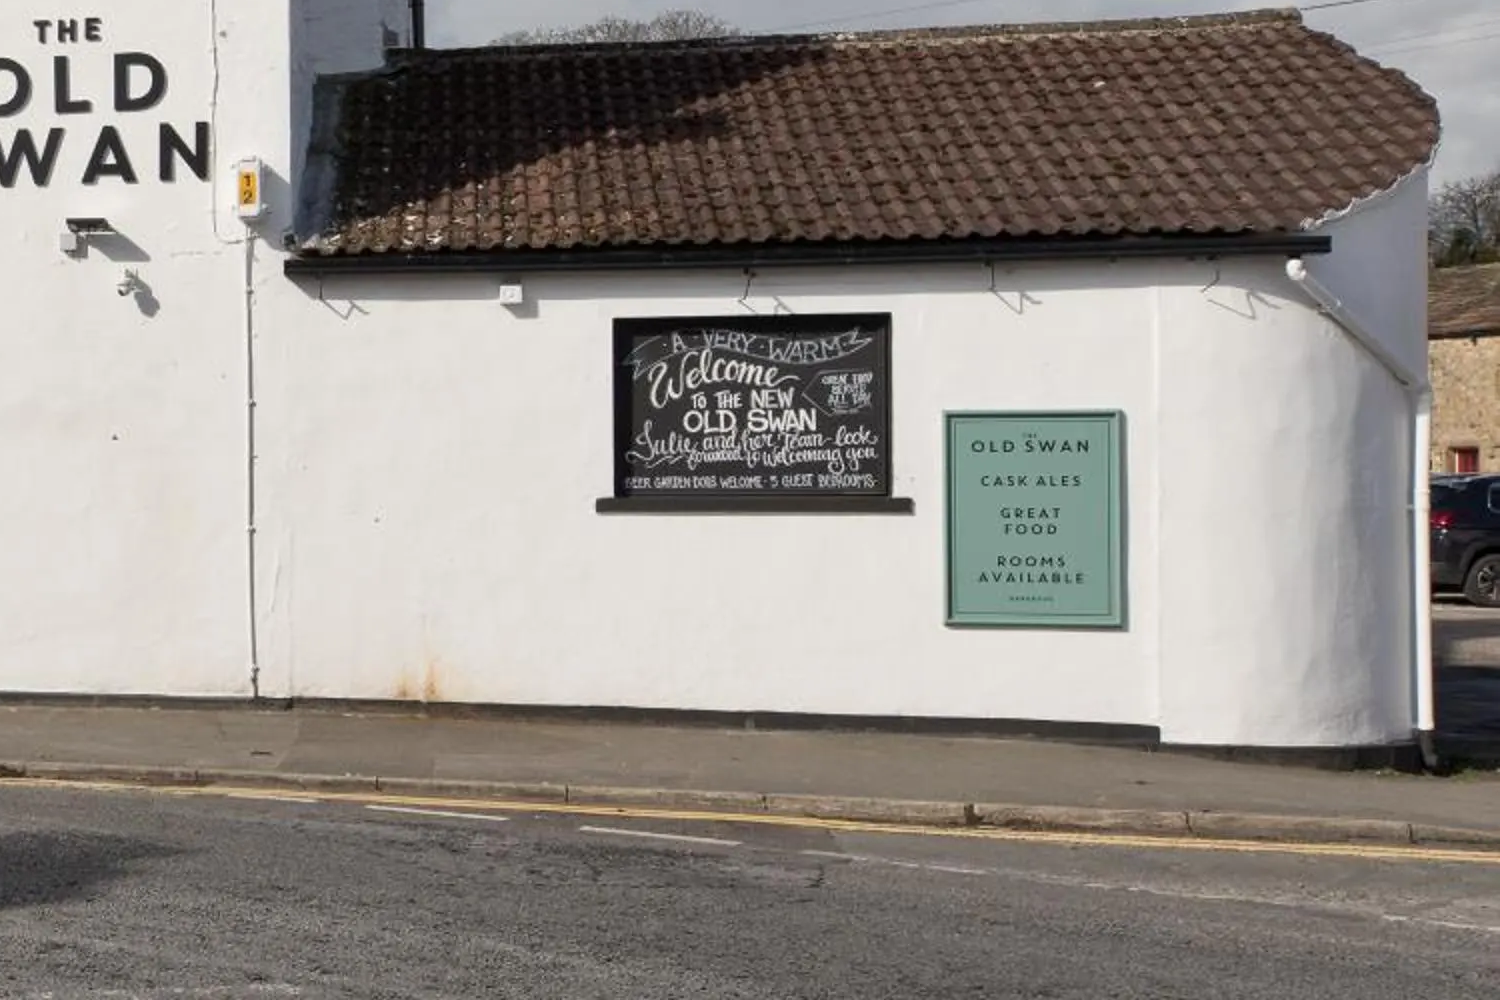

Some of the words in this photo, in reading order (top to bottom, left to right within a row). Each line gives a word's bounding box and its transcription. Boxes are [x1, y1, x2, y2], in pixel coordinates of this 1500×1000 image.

[33, 17, 104, 44] THE
[243, 190, 253, 204] 2
[673, 331, 686, 352] A
[701, 329, 757, 354] VERY
[769, 337, 842, 362] WARM
[648, 350, 801, 409] Welcome
[691, 394, 708, 409] TO
[715, 391, 742, 408] THE
[751, 387, 795, 409] NEW
[683, 410, 736, 433] OLD
[747, 408, 817, 433] SWAN
[625, 419, 692, 461] Julie
[703, 428, 738, 450] and
[741, 429, 775, 450] her
[834, 425, 879, 446] look
[971, 440, 1015, 453] OLD
[1024, 439, 1090, 453] SWAN
[746, 448, 761, 468] to
[845, 447, 878, 471] you
[781, 474, 813, 488] GUEST
[980, 475, 1029, 487] CASK
[1035, 475, 1082, 487] ALES
[1000, 507, 1061, 519] GREAT
[1004, 523, 1058, 535] FOOD
[997, 555, 1066, 567] ROOMS
[978, 572, 1086, 584] AVAILABLE
